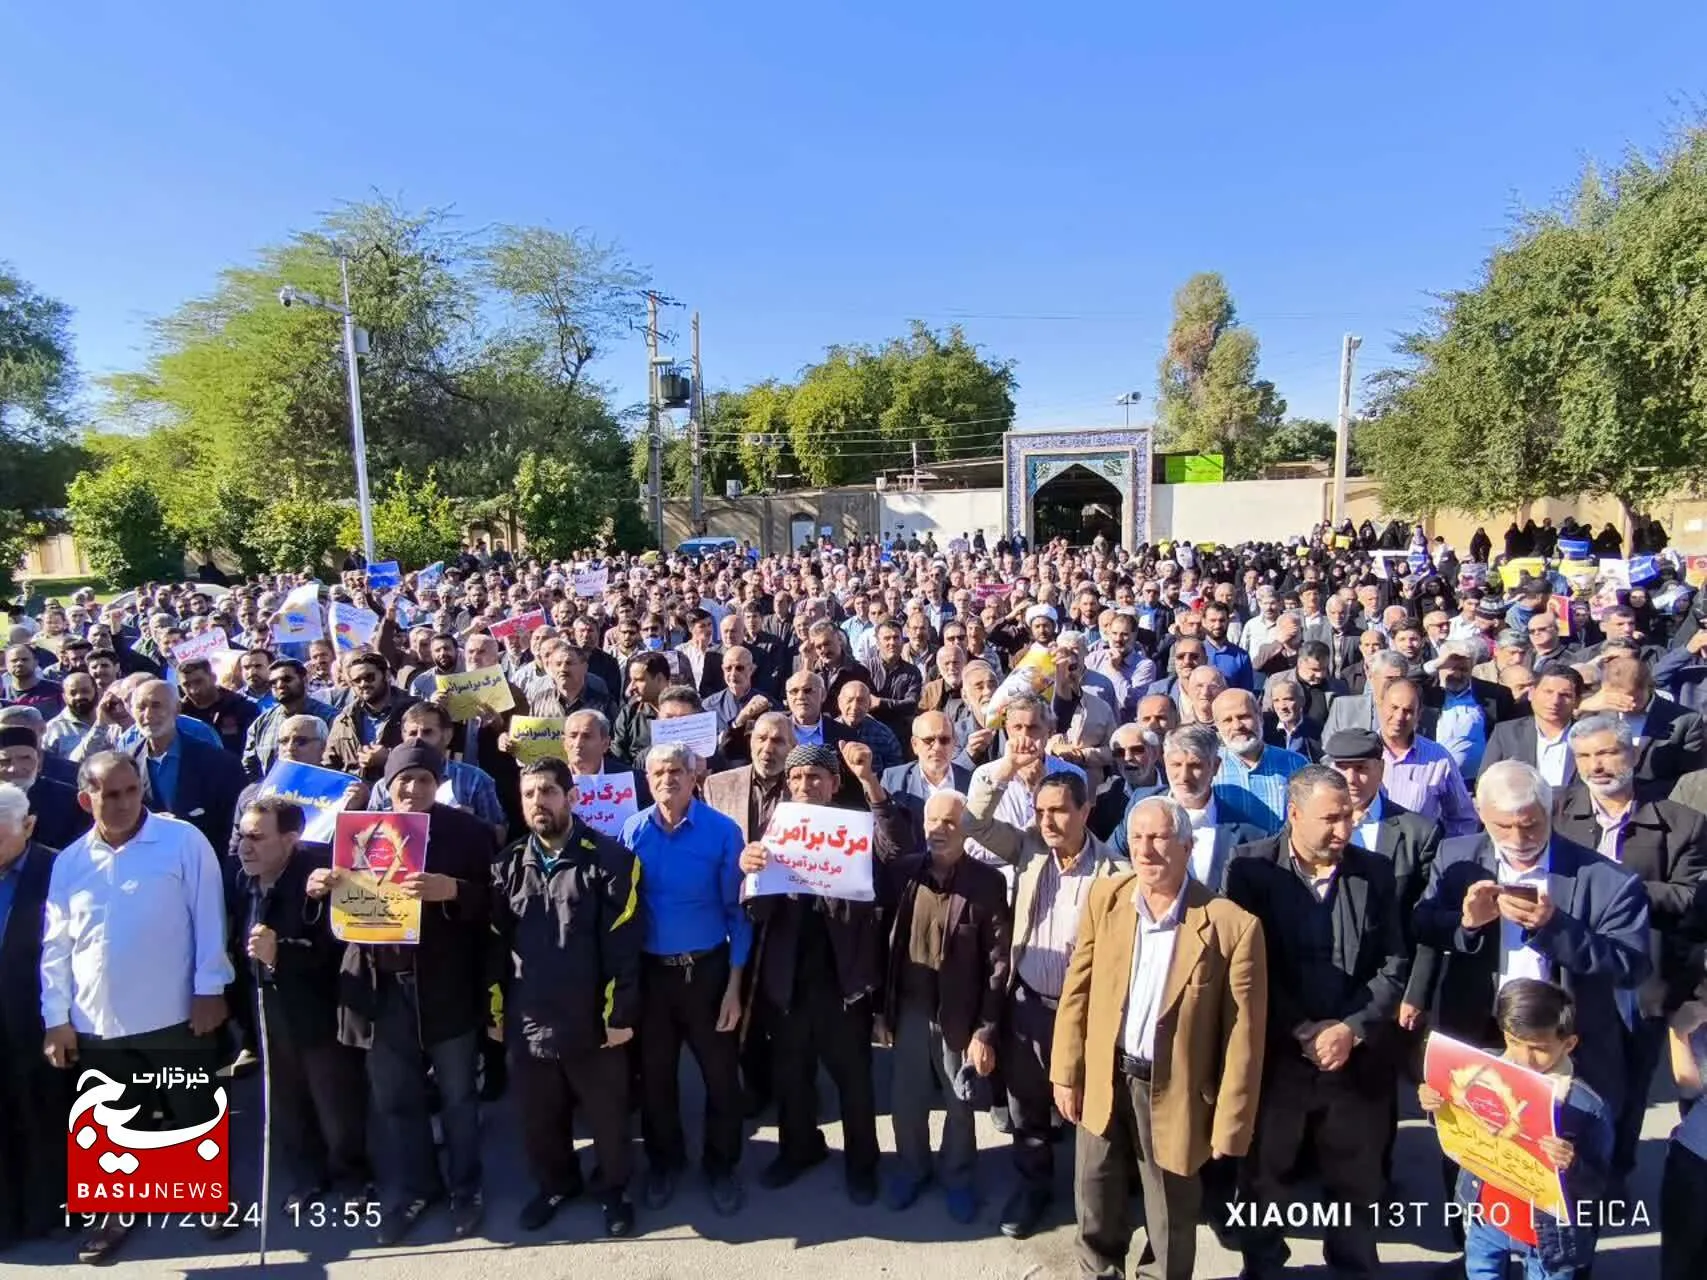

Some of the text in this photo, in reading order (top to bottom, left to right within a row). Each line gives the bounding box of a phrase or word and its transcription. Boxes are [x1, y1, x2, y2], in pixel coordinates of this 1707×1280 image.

[580, 789, 596, 806] بر
[597, 783, 633, 804] مرگ
[804, 831, 825, 851] بر
[826, 825, 869, 856] مرگ
[818, 861, 842, 875] مرگ
